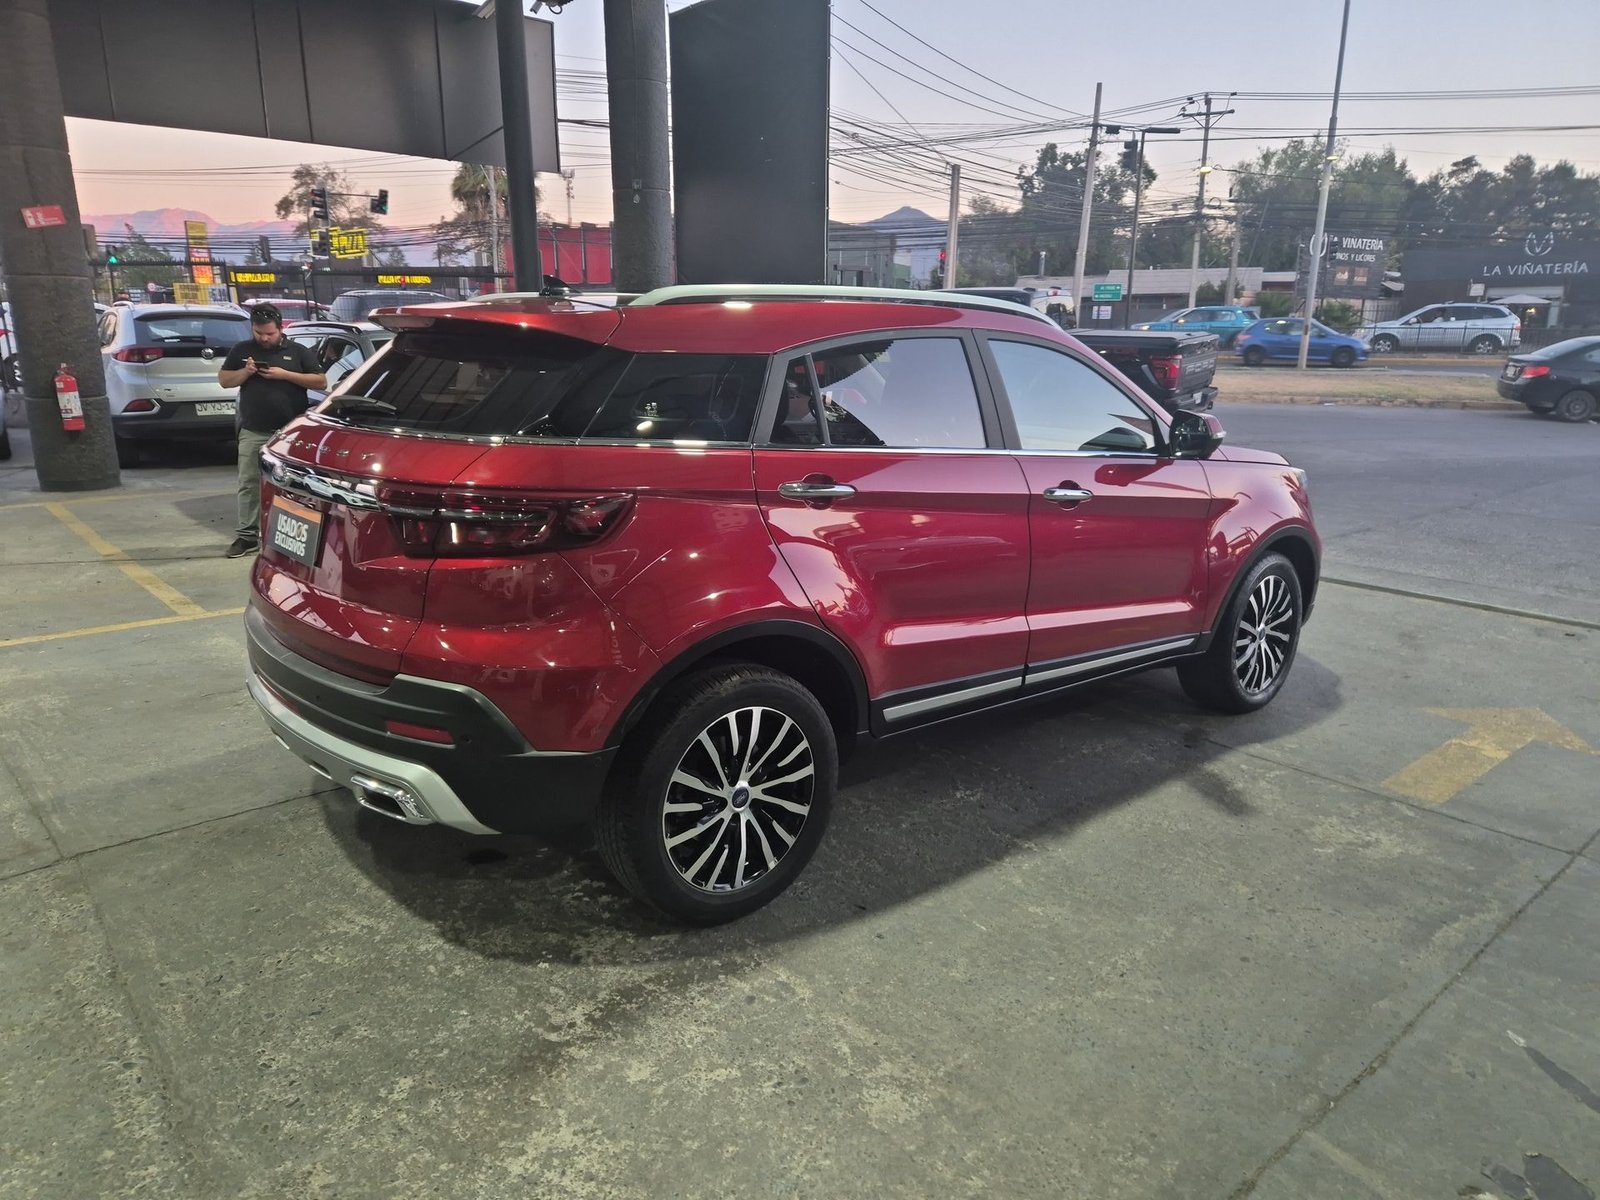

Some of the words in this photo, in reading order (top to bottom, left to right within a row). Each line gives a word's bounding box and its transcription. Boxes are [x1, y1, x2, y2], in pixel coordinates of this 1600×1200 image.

[1355, 254, 1376, 262] LICORES
[1483, 265, 1501, 276] LA
[1508, 260, 1588, 275] VIÑATERÍA
[277, 513, 309, 542] USADOS
[274, 531, 306, 557] EXCLUSIVOS
